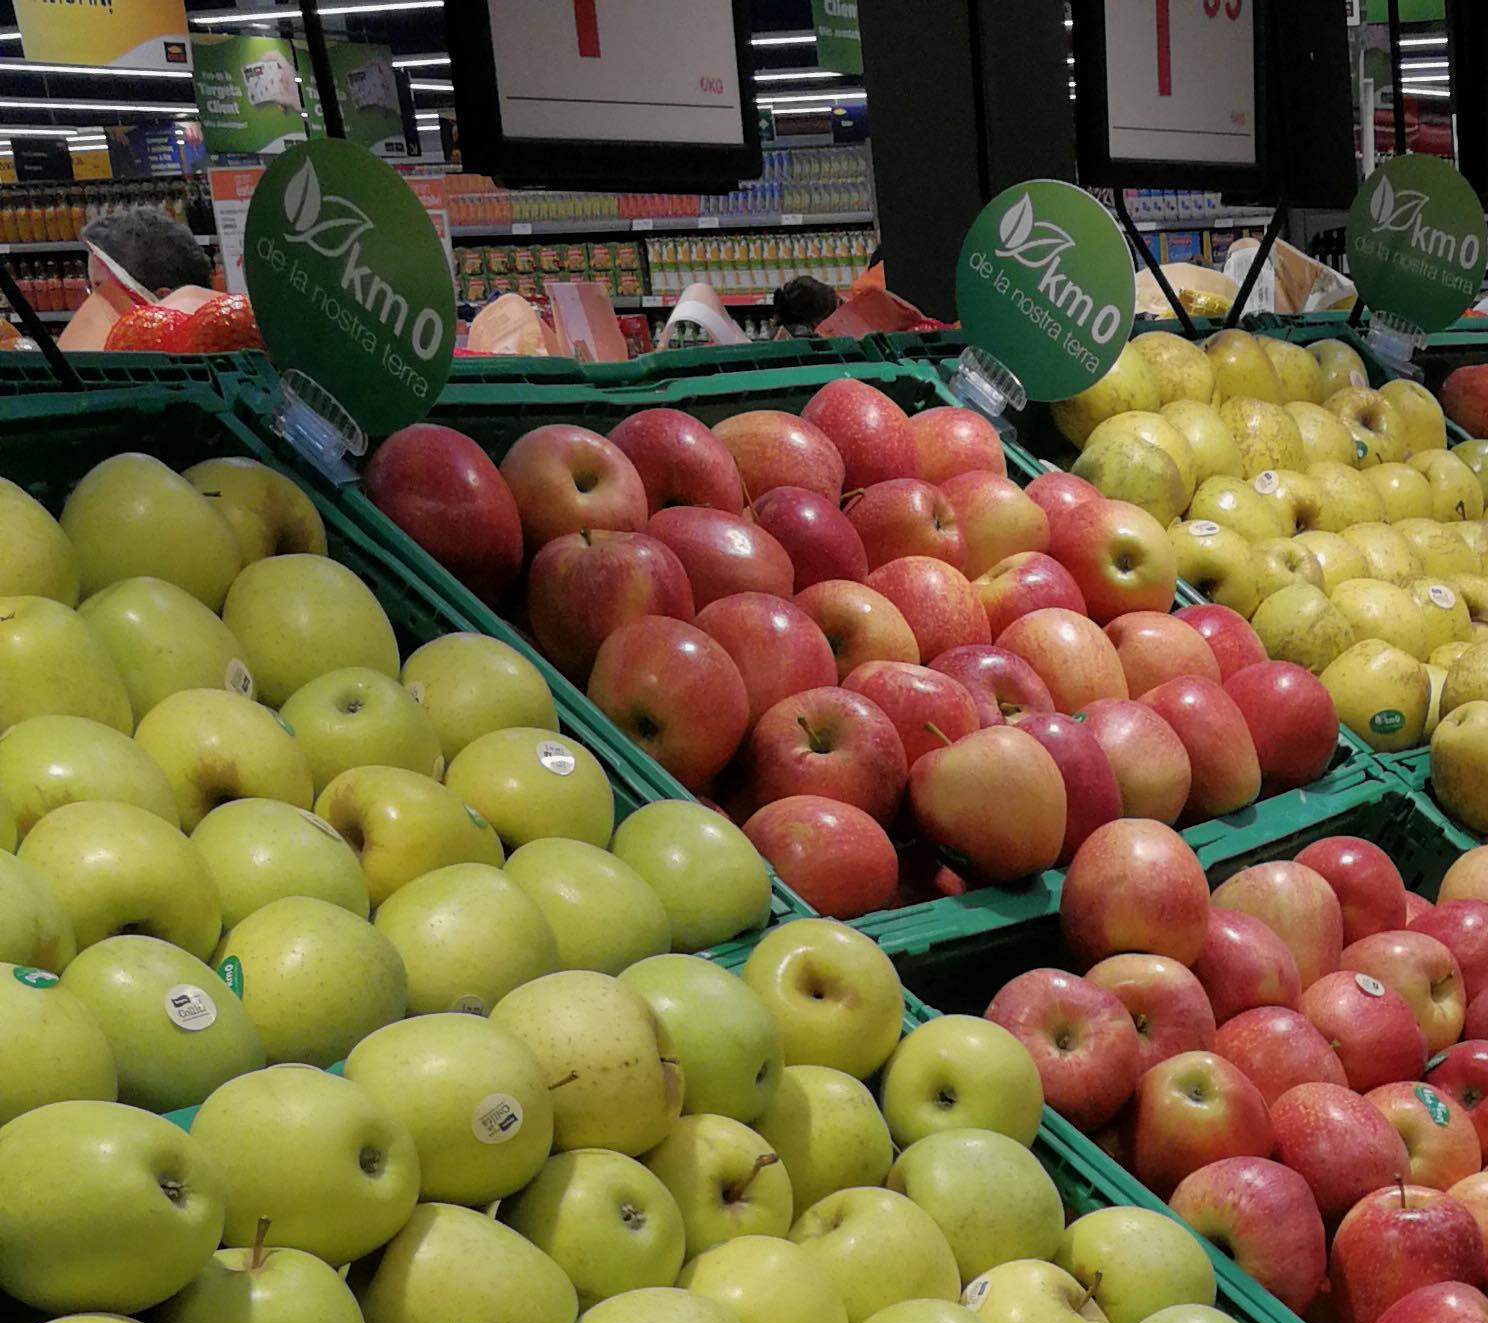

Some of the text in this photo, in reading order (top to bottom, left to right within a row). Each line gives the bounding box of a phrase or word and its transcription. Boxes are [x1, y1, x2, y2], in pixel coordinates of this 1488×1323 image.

[257, 236, 429, 398] de la nostra terra
[969, 251, 1100, 374] de la nostra terra
